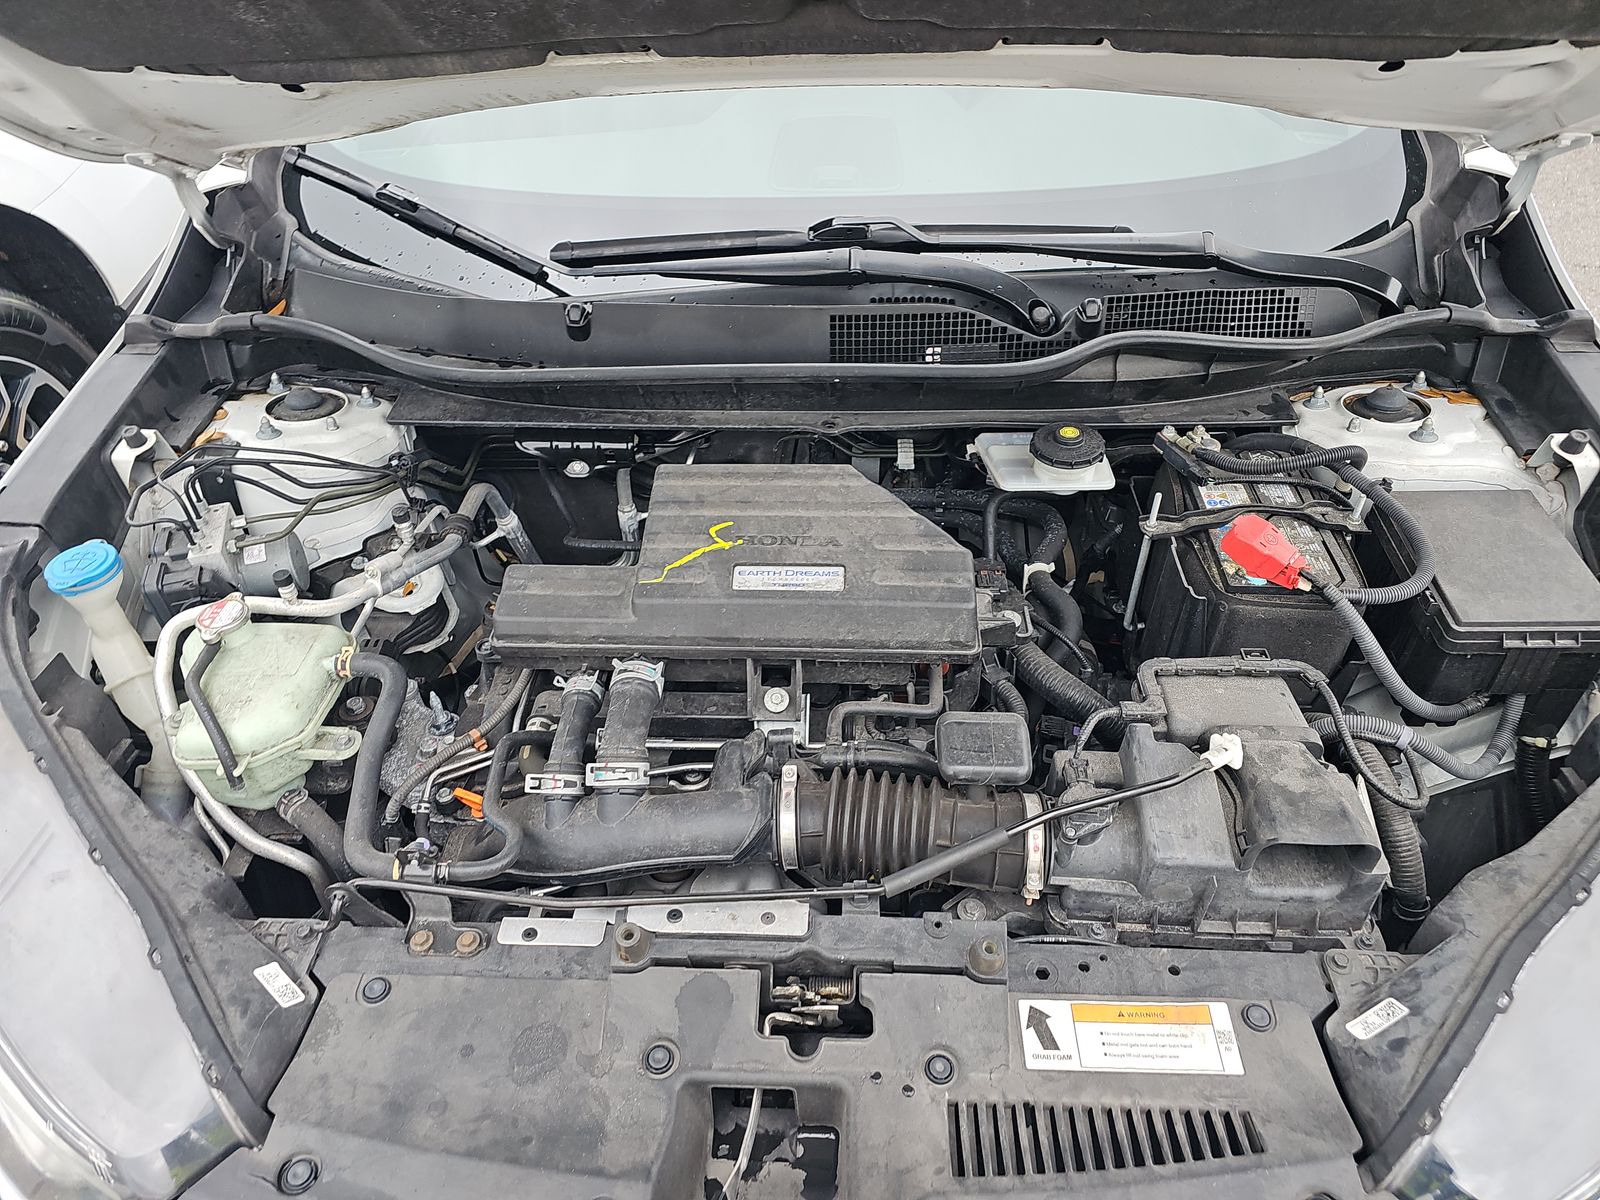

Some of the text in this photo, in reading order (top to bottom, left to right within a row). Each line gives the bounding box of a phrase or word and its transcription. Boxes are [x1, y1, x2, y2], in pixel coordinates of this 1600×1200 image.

[735, 535, 844, 547] HONDA
[785, 569, 840, 577] DREAMS
[1126, 1011, 1166, 1019] WARNING
